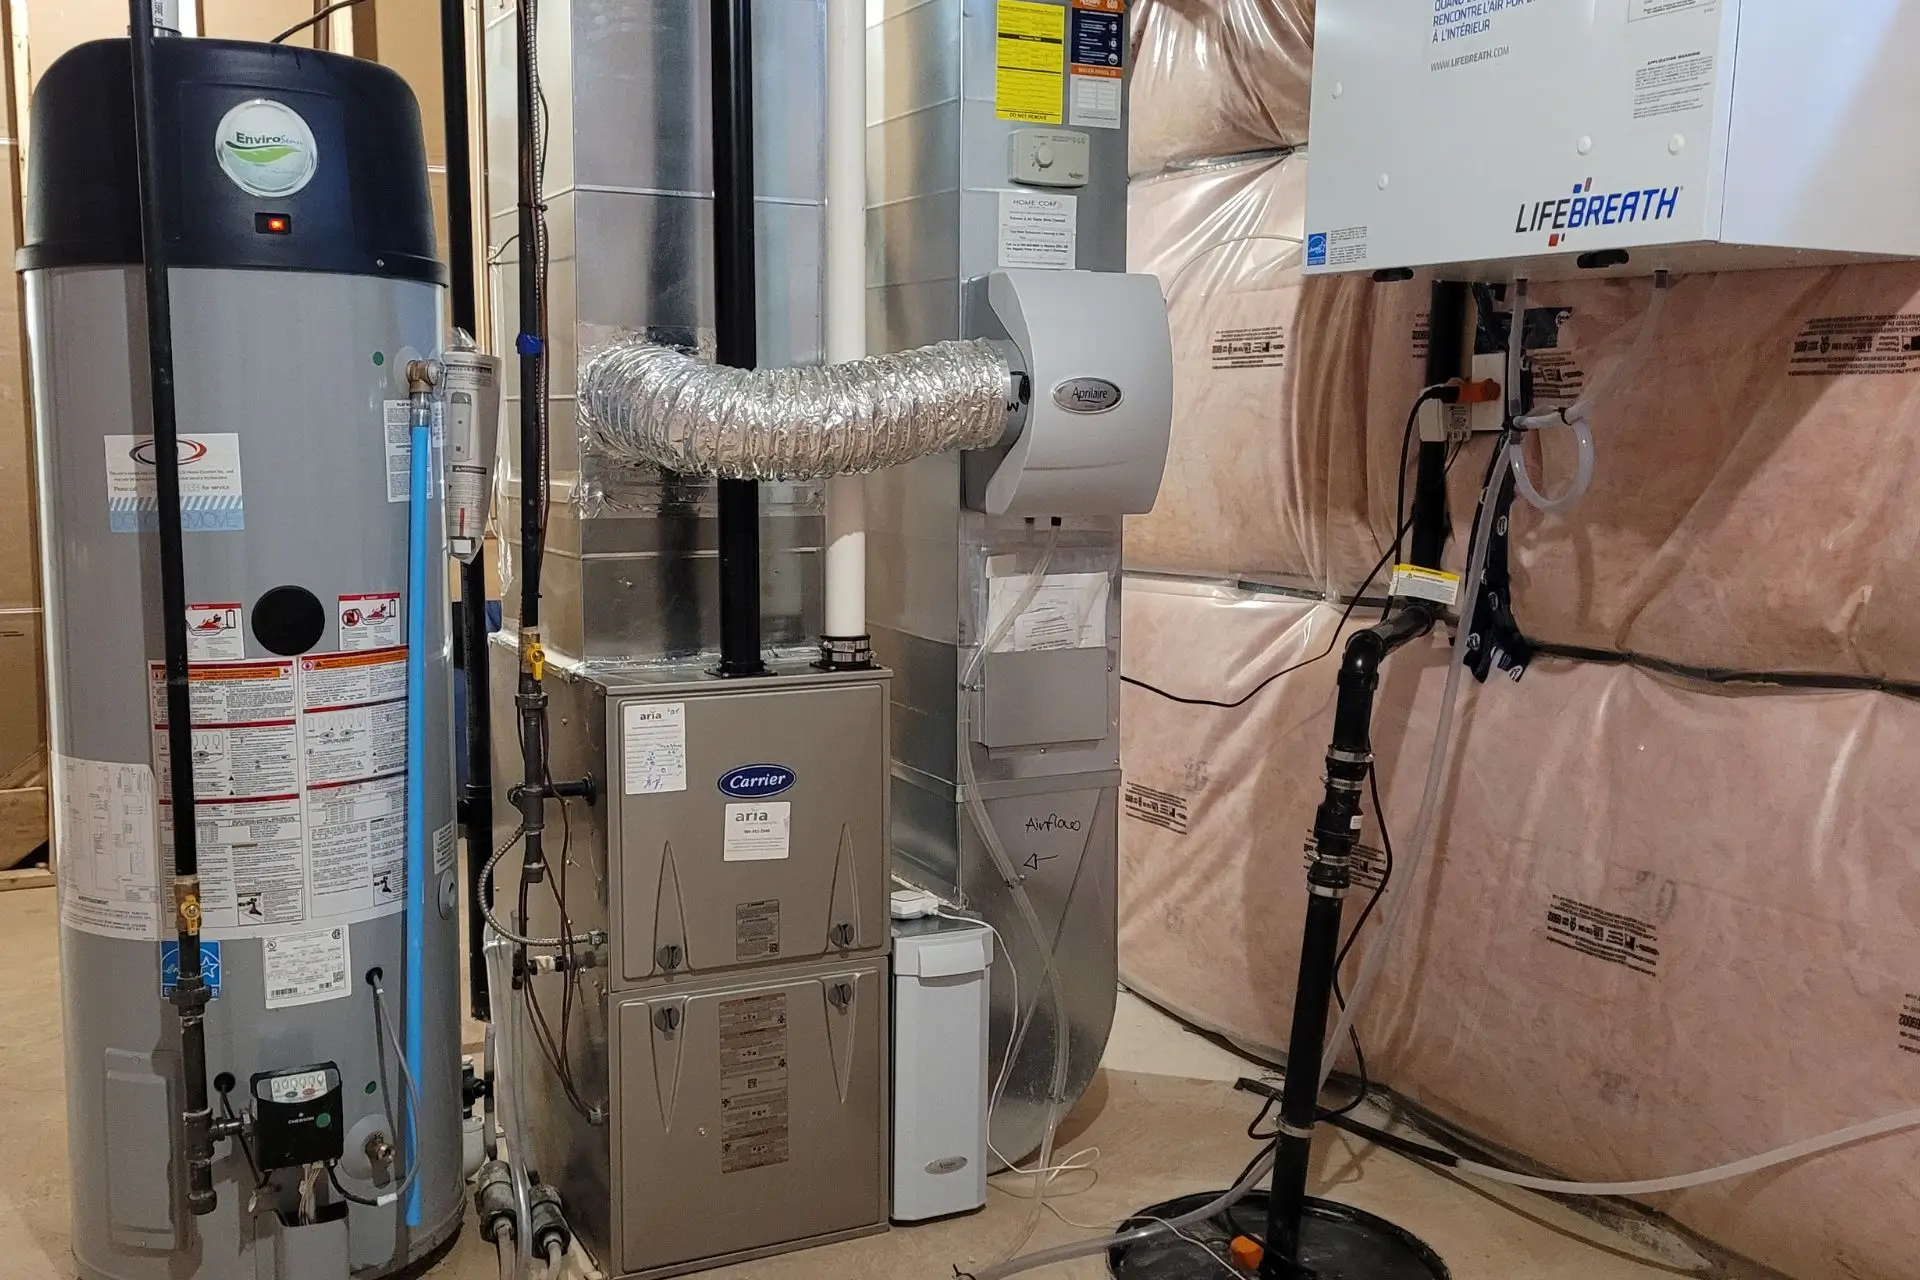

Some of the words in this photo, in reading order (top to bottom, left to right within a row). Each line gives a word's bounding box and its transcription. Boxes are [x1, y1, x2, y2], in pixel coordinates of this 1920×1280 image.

[1433, 4, 1482, 27] RENCONTRE
[1484, 0, 1504, 14] L'AIR
[1432, 28, 1438, 44] À
[1441, 19, 1491, 41] L'INTÉRIEUR
[1430, 46, 1510, 72] WWW.LIFEBREATH.COM
[1515, 186, 1680, 233] LIFEBREATH
[1072, 386, 1108, 403] Aprilaire
[640, 712, 662, 720] aria
[730, 773, 786, 788] Carrier
[735, 810, 768, 822] aria
